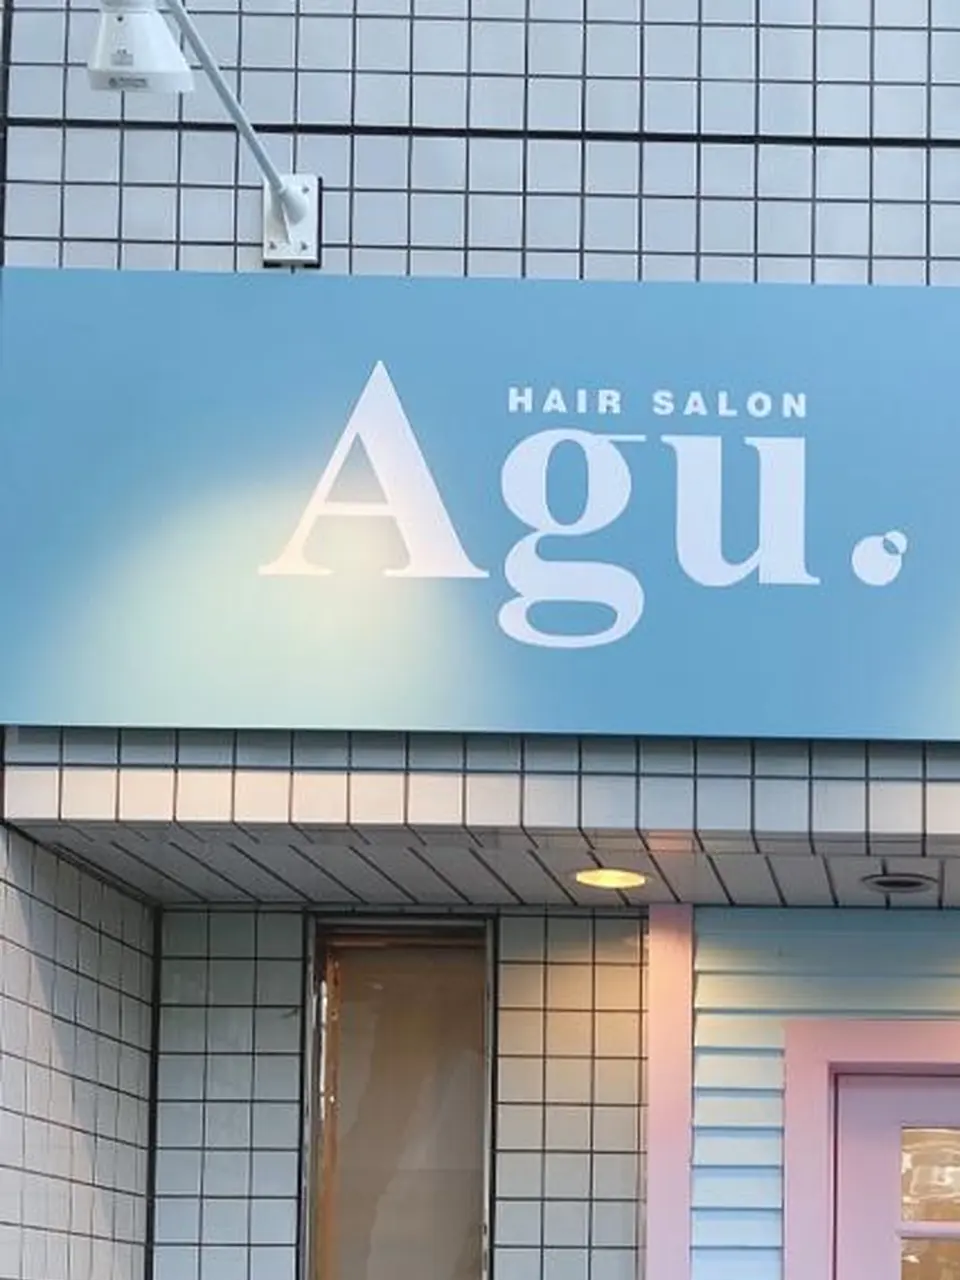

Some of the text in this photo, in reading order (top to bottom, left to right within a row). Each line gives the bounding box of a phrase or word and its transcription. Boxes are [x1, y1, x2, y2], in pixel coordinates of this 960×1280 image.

[507, 386, 807, 418] HAIR SALON
[257, 359, 908, 649] Agu.
